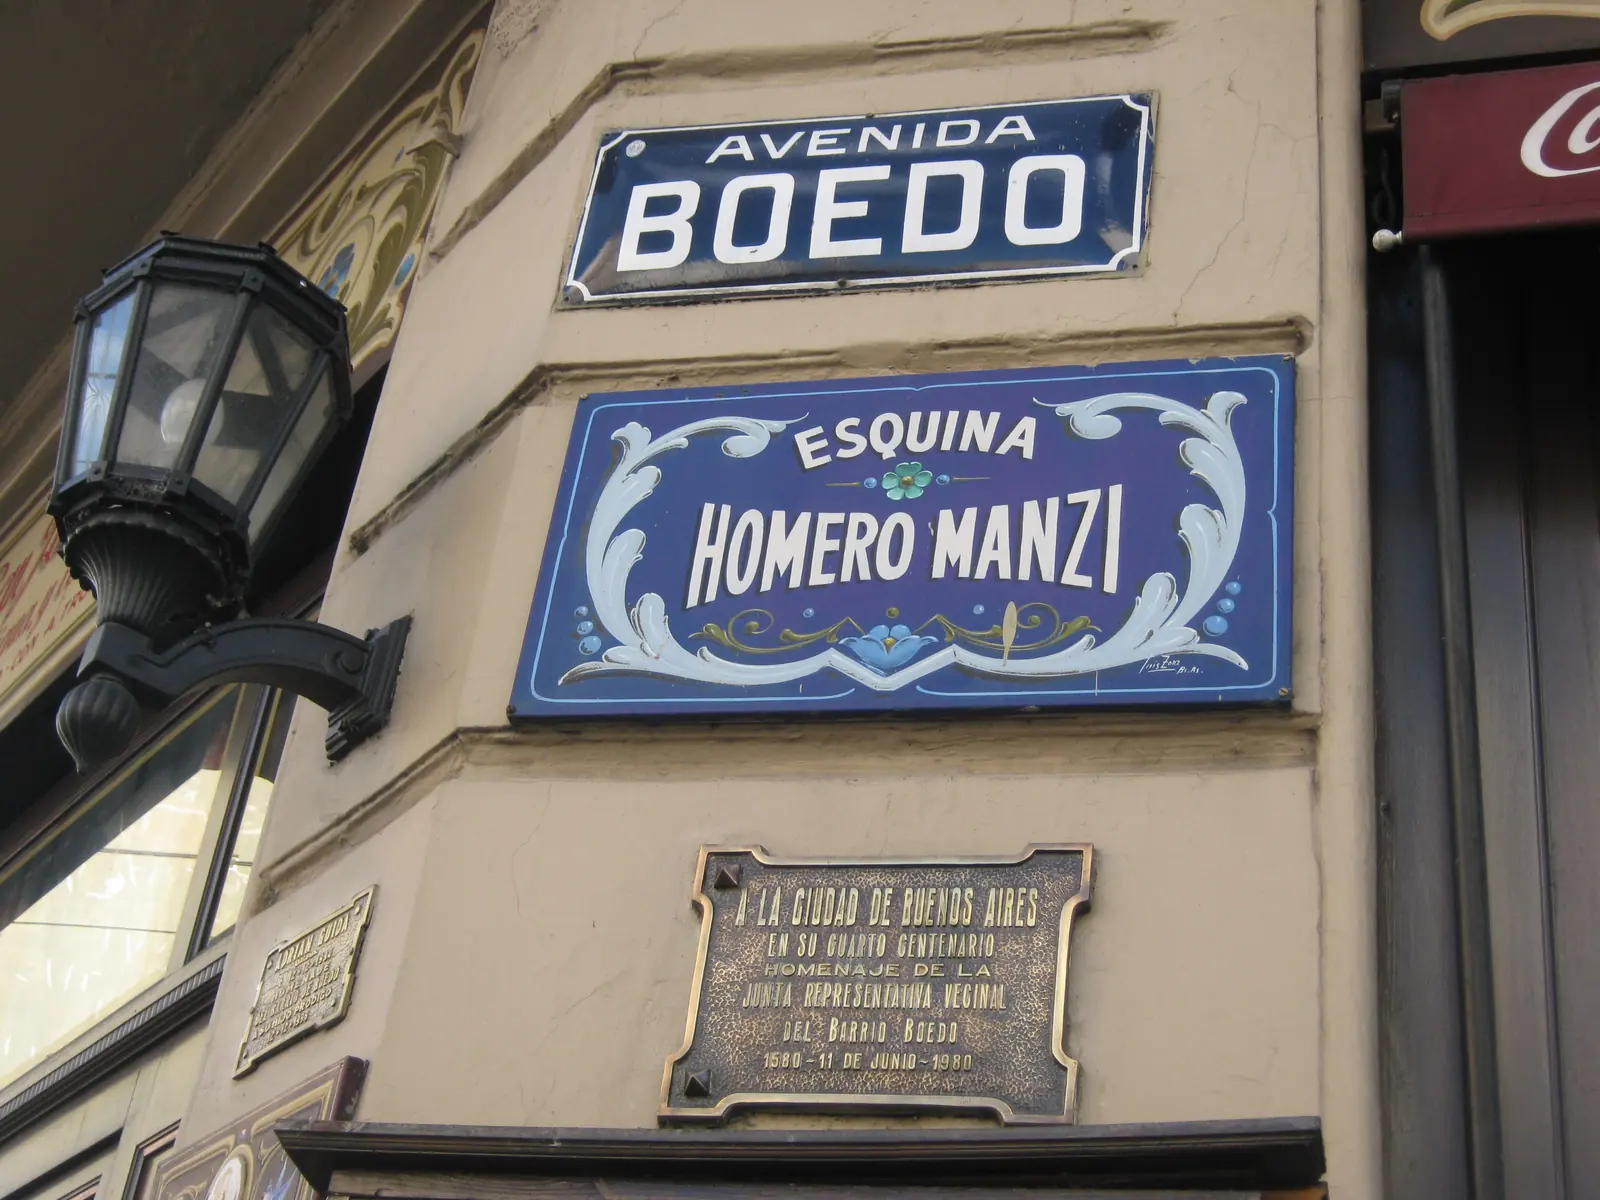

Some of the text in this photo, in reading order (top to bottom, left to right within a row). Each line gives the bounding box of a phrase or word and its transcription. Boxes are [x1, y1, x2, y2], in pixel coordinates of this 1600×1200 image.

[705, 115, 1036, 164] AVENIDA
[616, 154, 1086, 272] BOEDO
[794, 410, 1036, 469] ESQUINA
[685, 484, 1123, 610] HOMERO MANZI
[735, 886, 1038, 927] A LA CIUDAD DE BUENOS AIRES
[768, 933, 995, 958] EN SU CUARTO CENTENARIO
[764, 963, 991, 977] HOMENAJE DE LA
[742, 982, 1006, 1010] JUNTA REPRESENTATIVA VECINAL
[783, 1020, 811, 1042] DEL
[843, 1052, 863, 1070] DE
